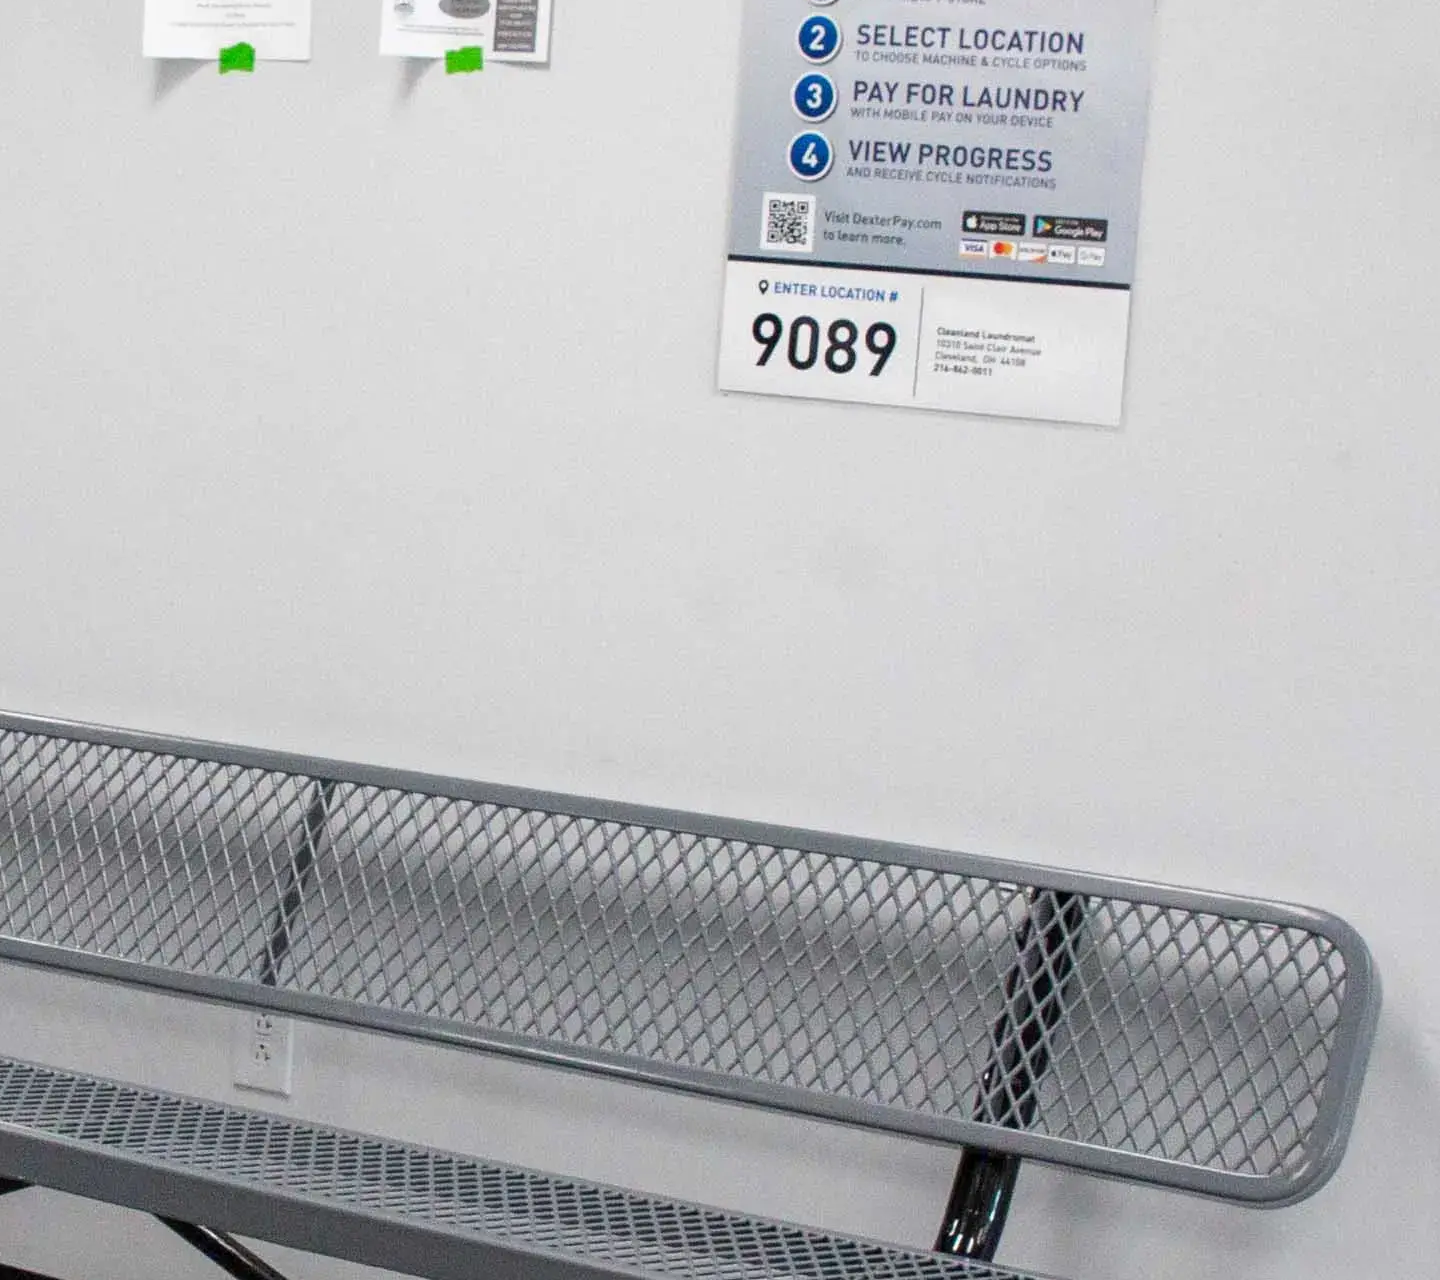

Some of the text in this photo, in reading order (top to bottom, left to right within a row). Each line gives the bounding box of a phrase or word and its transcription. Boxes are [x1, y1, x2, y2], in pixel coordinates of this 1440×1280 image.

[857, 25, 950, 50] SELECT
[959, 28, 1084, 53] LOCATION
[856, 51, 868, 61] TO
[872, 51, 919, 64] CHOOSE
[922, 54, 977, 67] MACHINE
[992, 57, 1031, 69] CYCLE
[1034, 59, 1086, 72] OPTIONS
[854, 82, 899, 105] PAY
[906, 83, 953, 107] FOR
[963, 85, 1084, 112] LAUNDRY
[851, 108, 1053, 128] WITH MOBILE PAY ON YOUR DEVICE
[849, 140, 911, 164] VIEW
[919, 144, 1052, 171] PROGRESS
[847, 167, 1056, 190] AND RECEIVE CYCLE NOTIFICATIONS
[825, 211, 942, 231] Visit DexterPay.com
[824, 231, 837, 242] to
[841, 230, 868, 244] learn
[774, 282, 899, 302] ENTER LOCATION #
[753, 313, 896, 376] 9089
